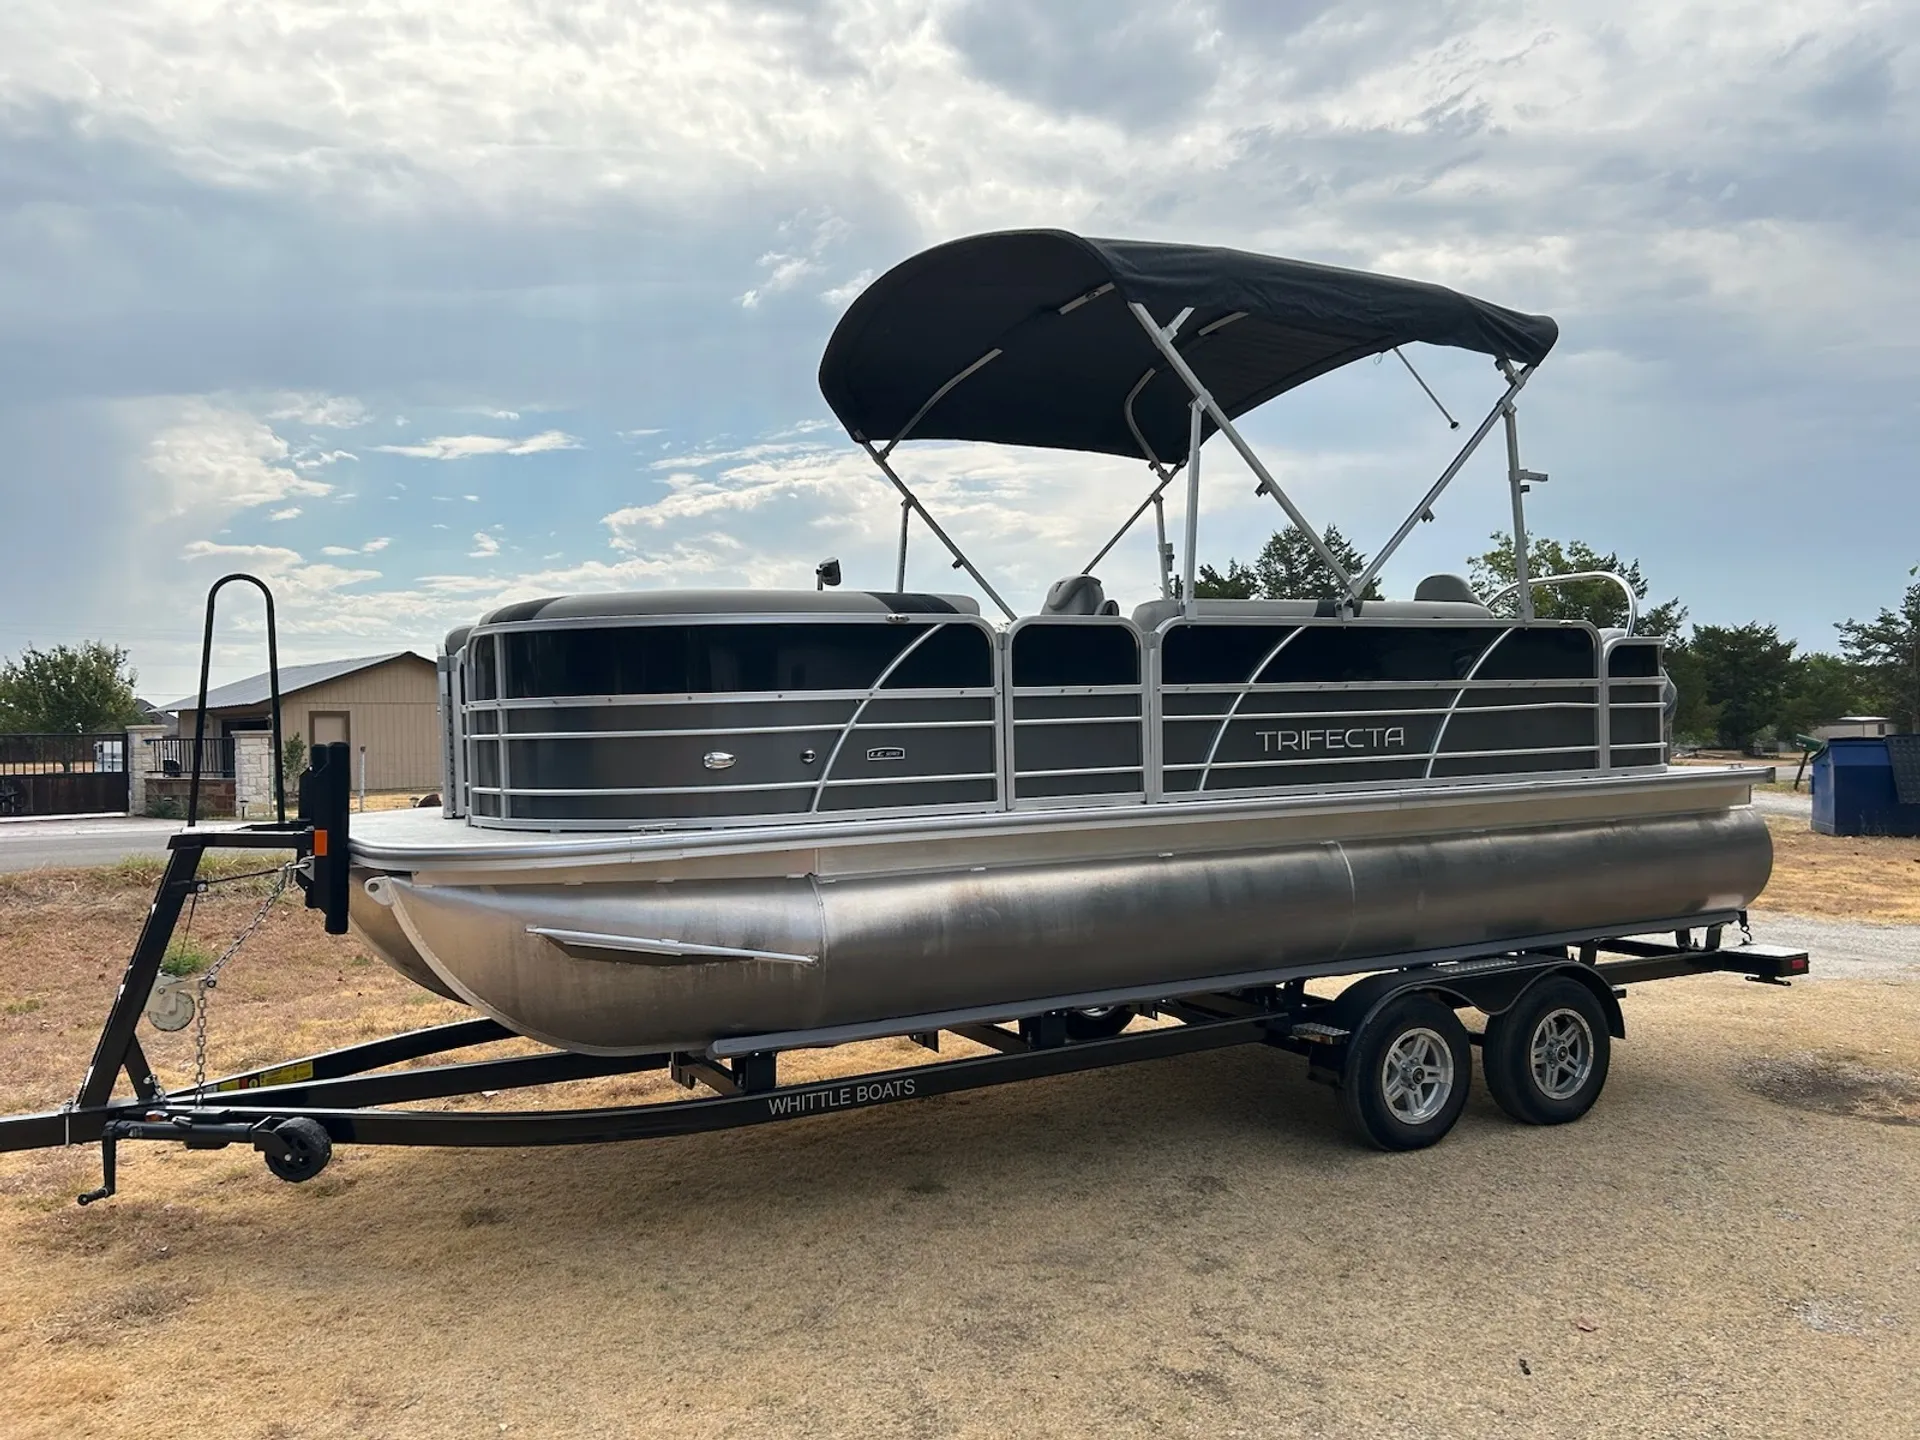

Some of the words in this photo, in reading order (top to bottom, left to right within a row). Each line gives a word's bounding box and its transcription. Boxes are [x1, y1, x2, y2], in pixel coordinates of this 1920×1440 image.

[1255, 727, 1405, 752] TRIFECTA
[768, 1088, 851, 1115] WHITTLE
[856, 1078, 915, 1103] BOATS
